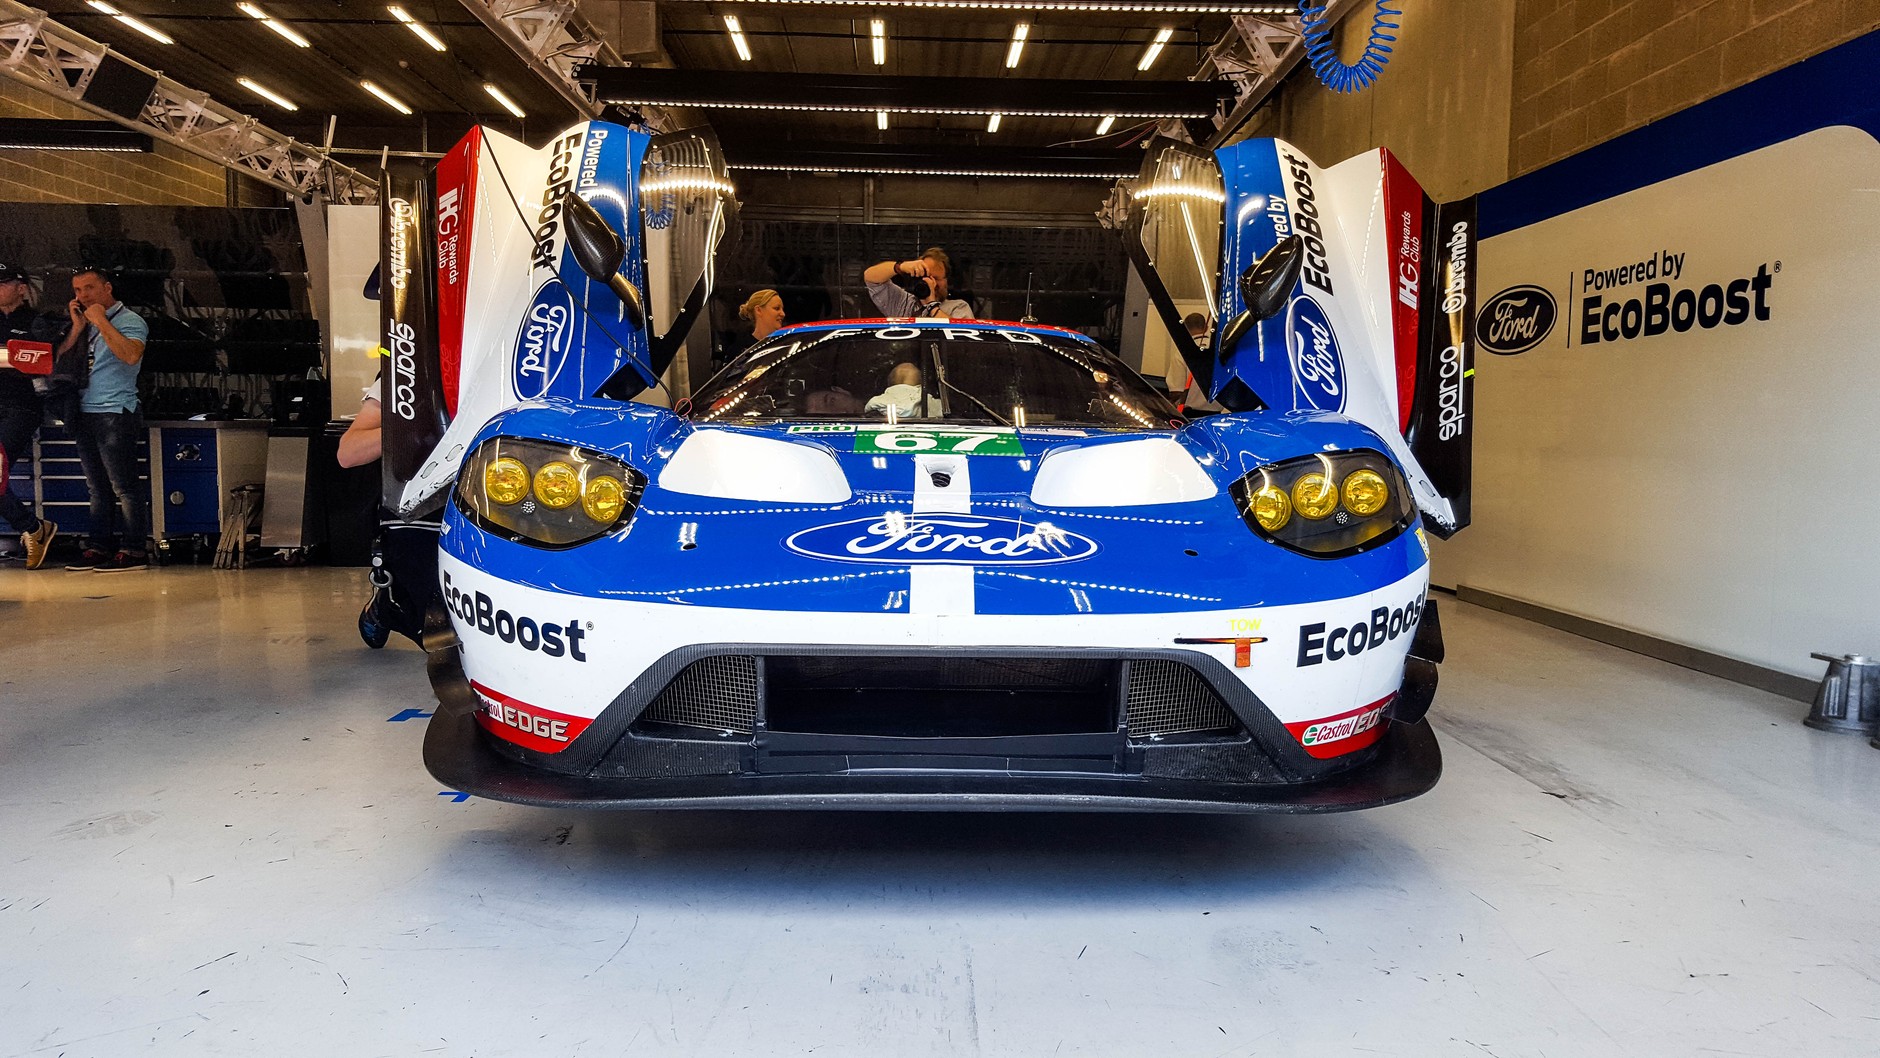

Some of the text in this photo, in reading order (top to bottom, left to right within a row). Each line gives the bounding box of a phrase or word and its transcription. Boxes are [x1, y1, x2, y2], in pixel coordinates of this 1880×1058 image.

[580, 130, 608, 188] Powered
[439, 187, 458, 235] IHG
[1266, 194, 1289, 244] ered by
[1283, 152, 1334, 296] EcoBoost
[1401, 210, 1411, 258] Rewards
[439, 241, 449, 269] Club
[449, 234, 459, 285] Rewards
[1410, 236, 1420, 263] Club
[1444, 221, 1468, 295] brembo
[1583, 250, 1685, 294] Powered by
[1399, 262, 1418, 310] IHG
[520, 303, 567, 377] Ford
[818, 327, 1042, 344] FORD
[1489, 297, 1541, 343] Ford
[388, 320, 416, 421] sparco
[1295, 315, 1339, 396] Ford
[1438, 342, 1466, 442] sparco
[873, 431, 999, 451] 67
[846, 519, 1045, 557] Ford
[1229, 618, 1262, 632] TOW
[503, 705, 570, 742] EDGE
[1317, 719, 1354, 743] Castrol
